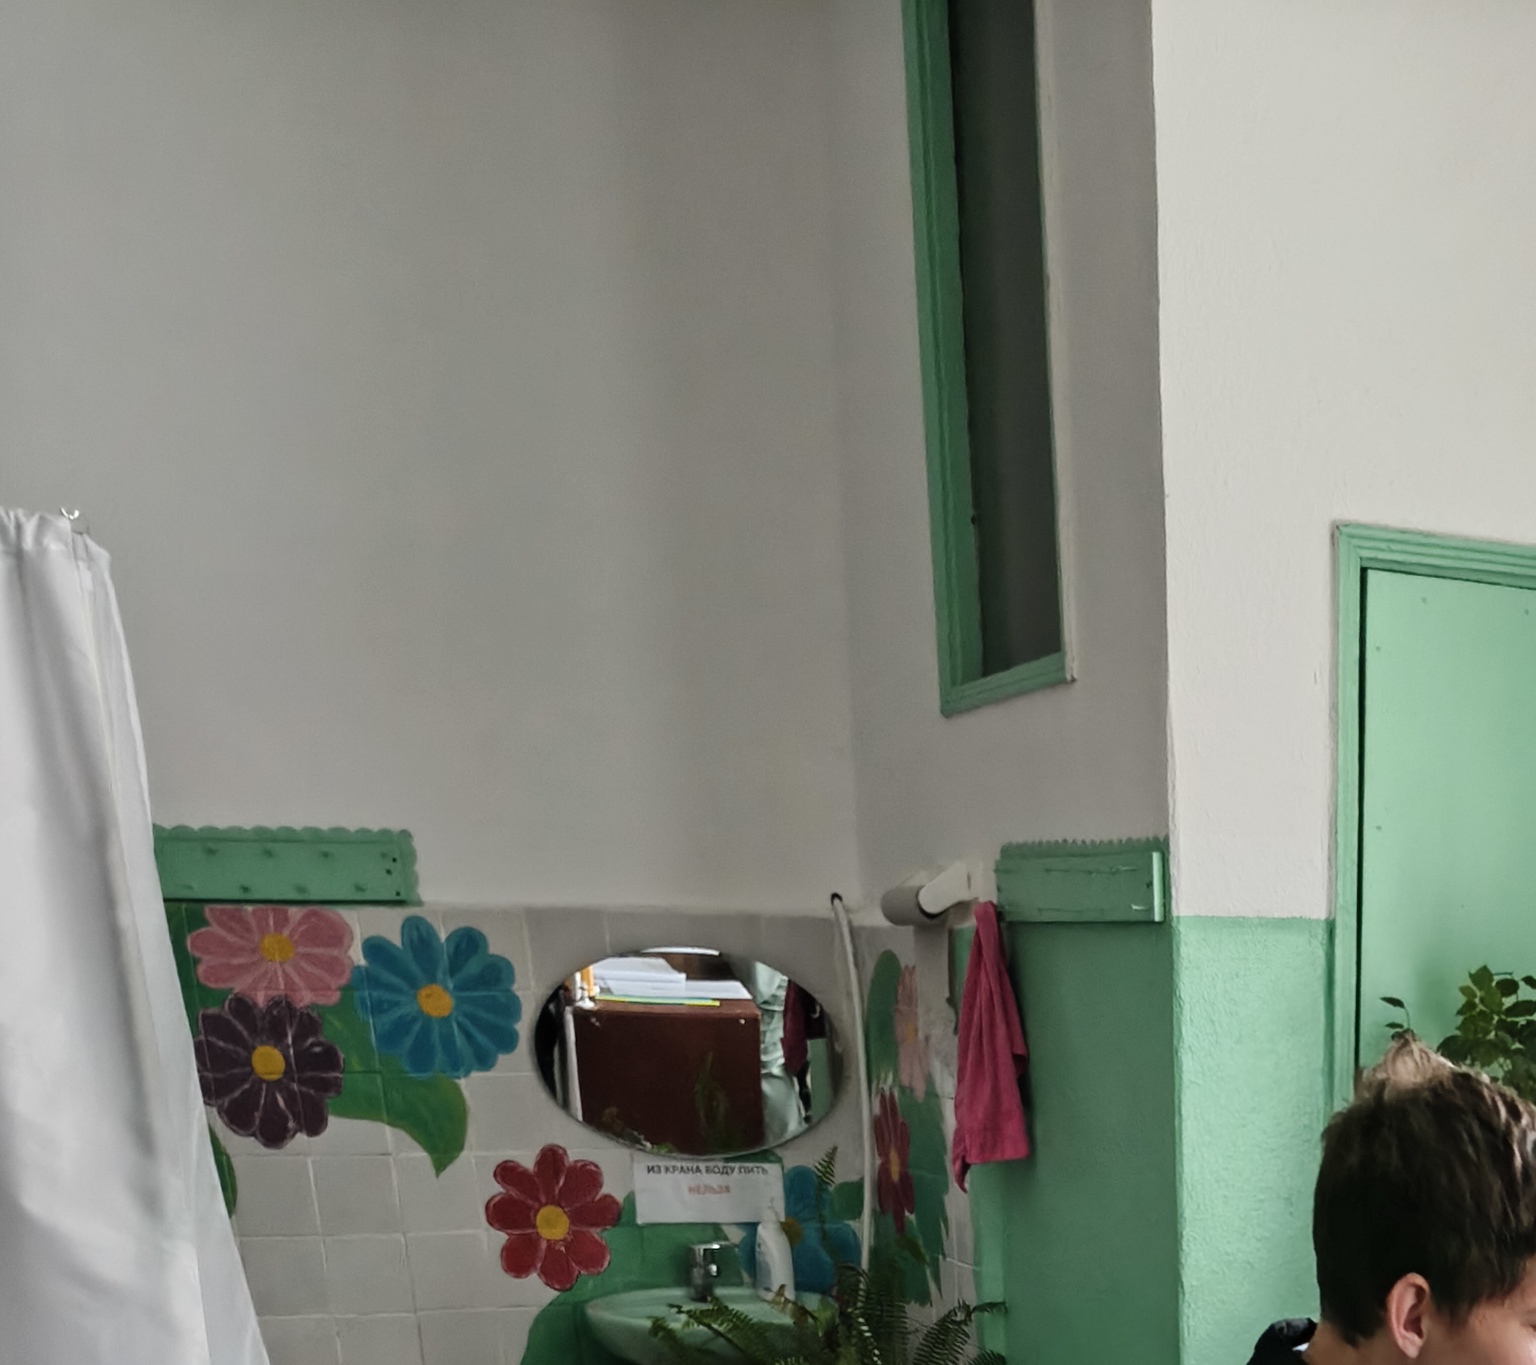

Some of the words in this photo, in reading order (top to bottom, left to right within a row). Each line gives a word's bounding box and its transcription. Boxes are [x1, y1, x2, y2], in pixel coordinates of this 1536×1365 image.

[646, 1165, 661, 1174] ИЗ
[664, 1165, 703, 1174] КРАНА
[705, 1165, 735, 1175] ВОДУ
